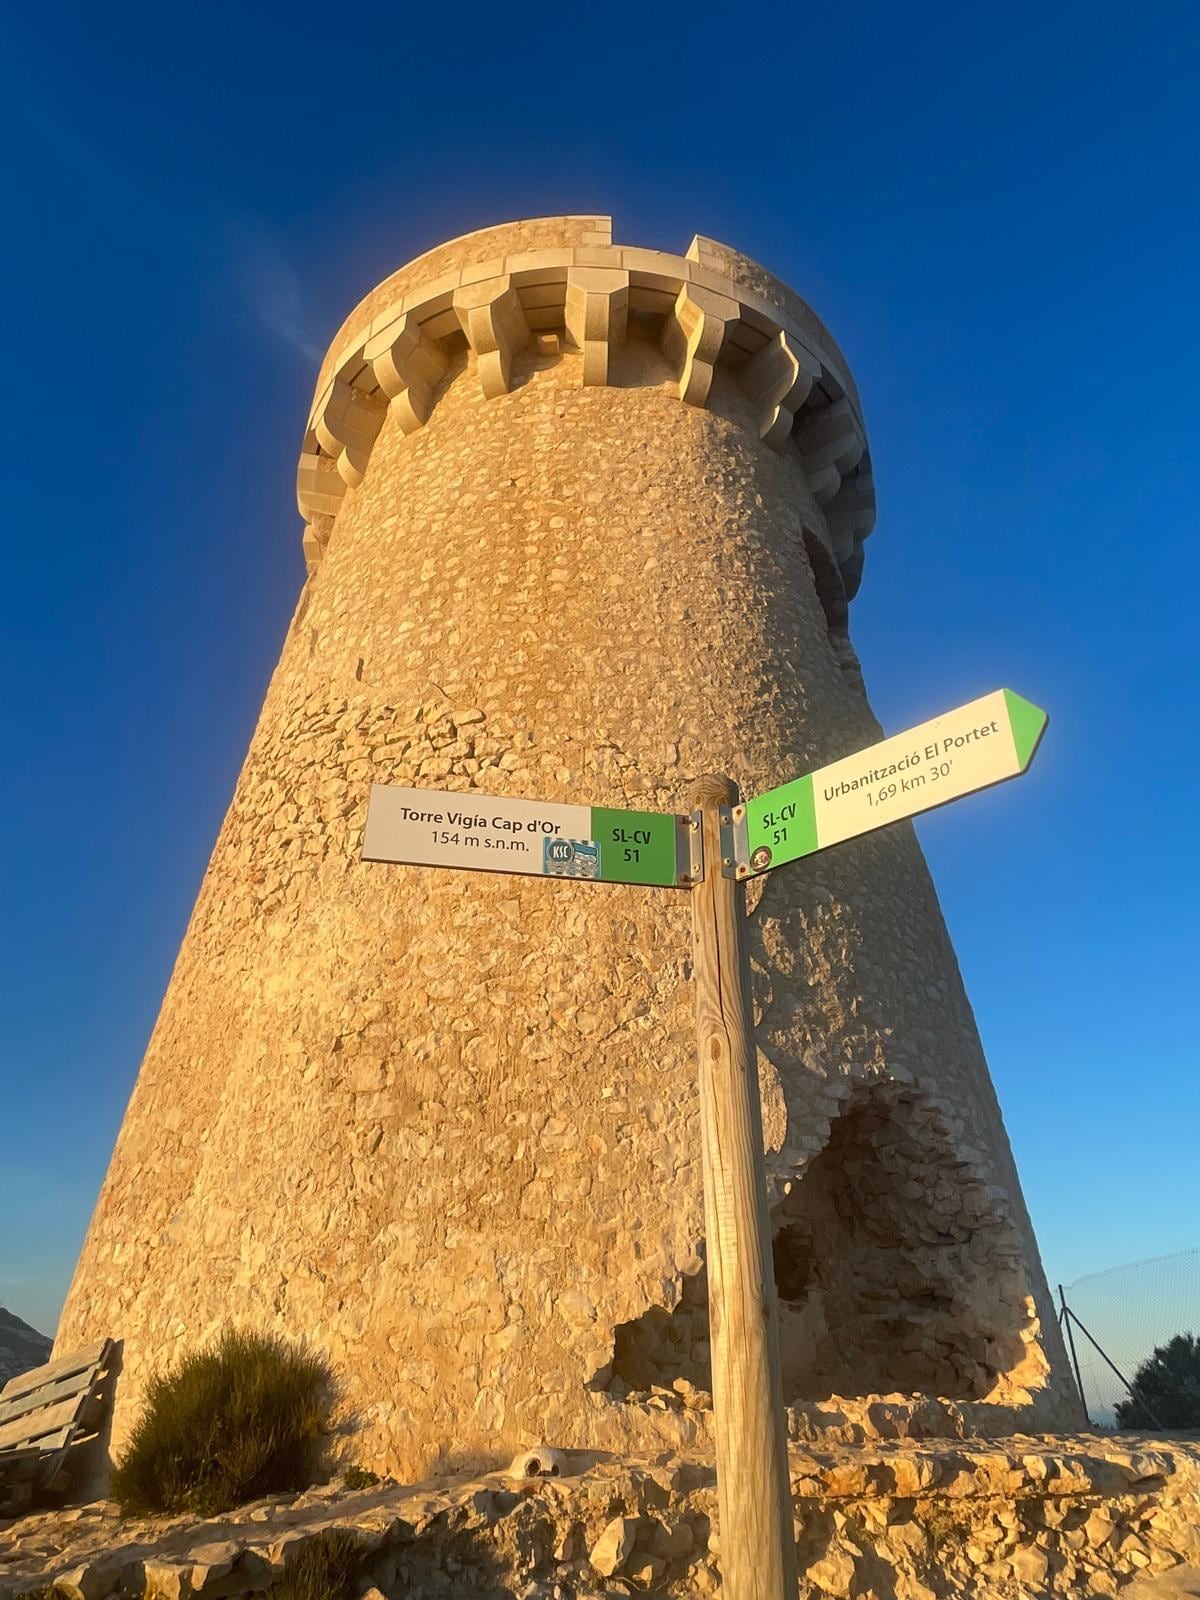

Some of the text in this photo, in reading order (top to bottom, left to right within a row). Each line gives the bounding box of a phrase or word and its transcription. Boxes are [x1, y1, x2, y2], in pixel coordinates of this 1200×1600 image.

[824, 720, 999, 801] Urbanització El Portet
[866, 760, 953, 807] 1,69 km 30'
[401, 807, 560, 835] Torre Vigía Cap d'Or
[763, 803, 796, 829] SL-CV
[431, 831, 529, 852] 154 m s.n.m.
[613, 828, 651, 844] SL-CV
[773, 828, 788, 845] 51
[553, 845, 569, 858] KSC
[624, 849, 640, 863] 51
